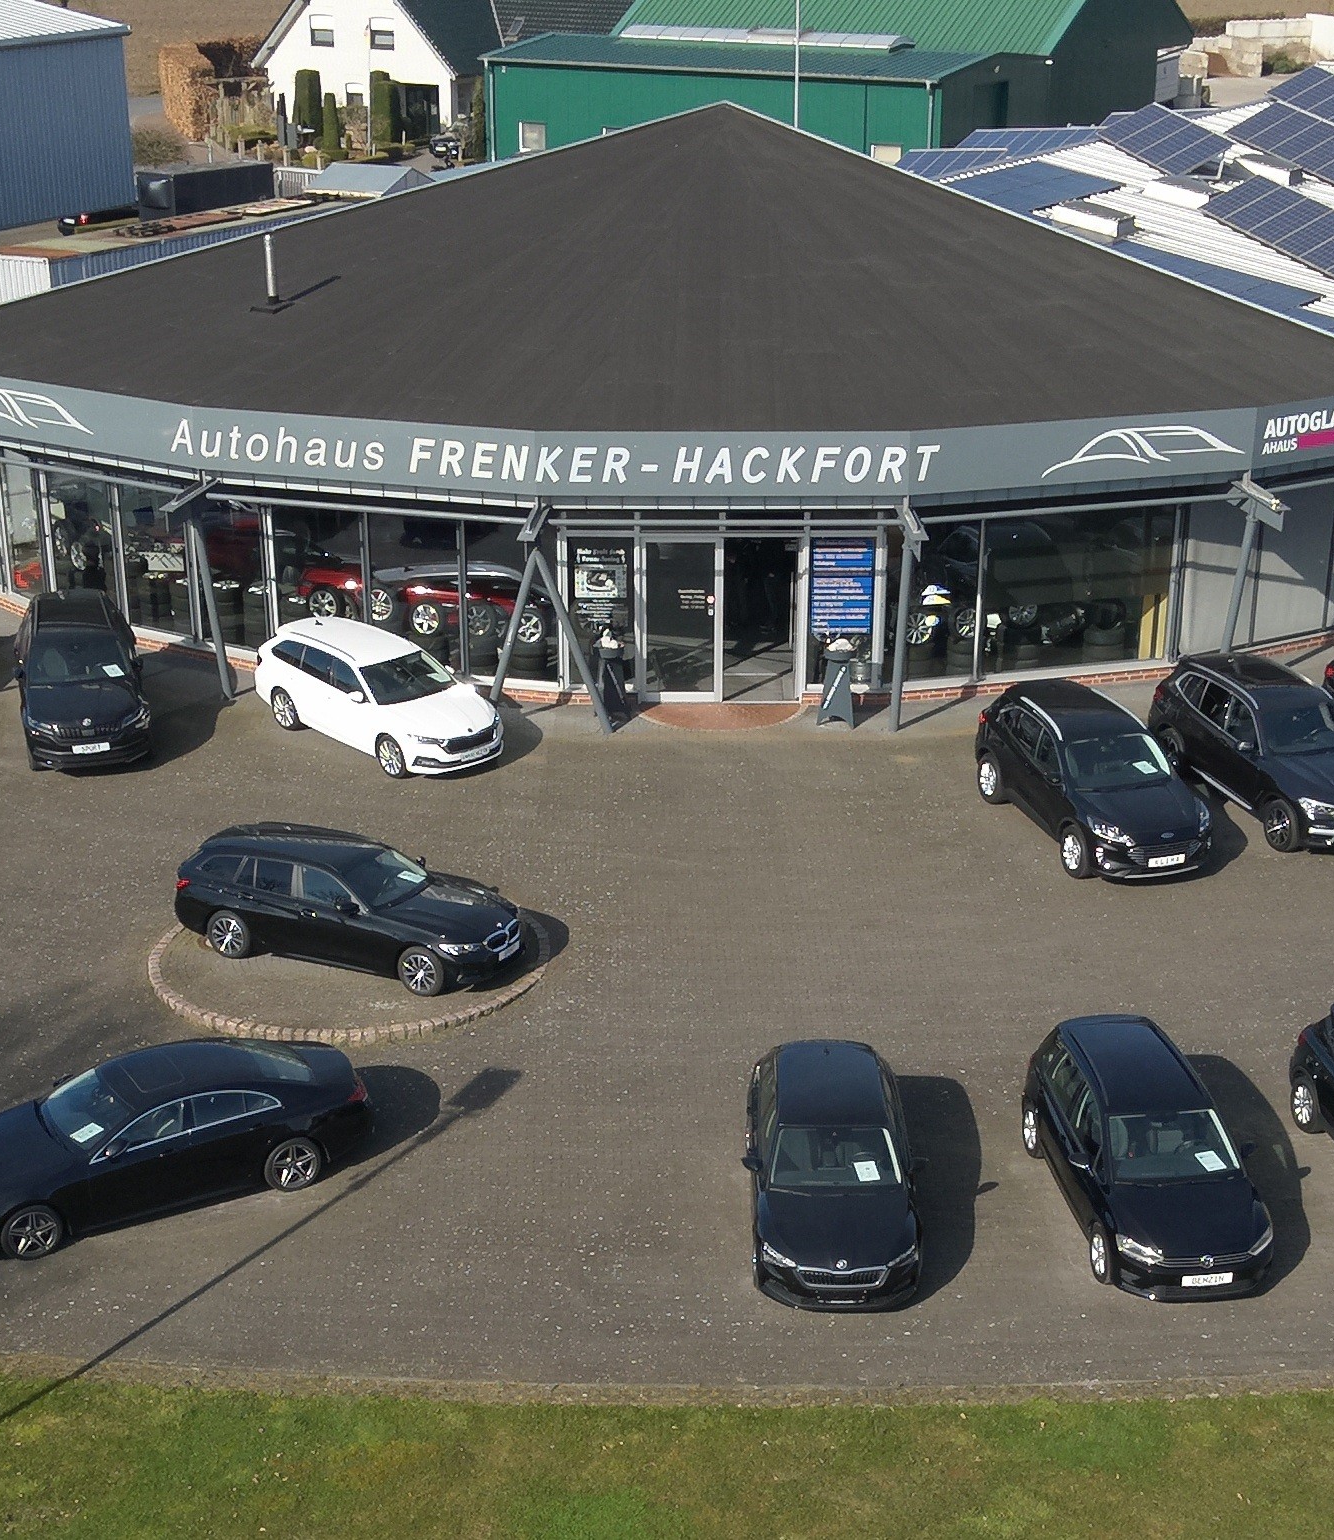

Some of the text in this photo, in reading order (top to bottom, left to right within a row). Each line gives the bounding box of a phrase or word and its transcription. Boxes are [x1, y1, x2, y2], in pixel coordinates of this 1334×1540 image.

[170, 417, 385, 471] Autohaus
[1261, 437, 1298, 456] AHAUS
[1191, 1275, 1225, 1285] BENZIN
